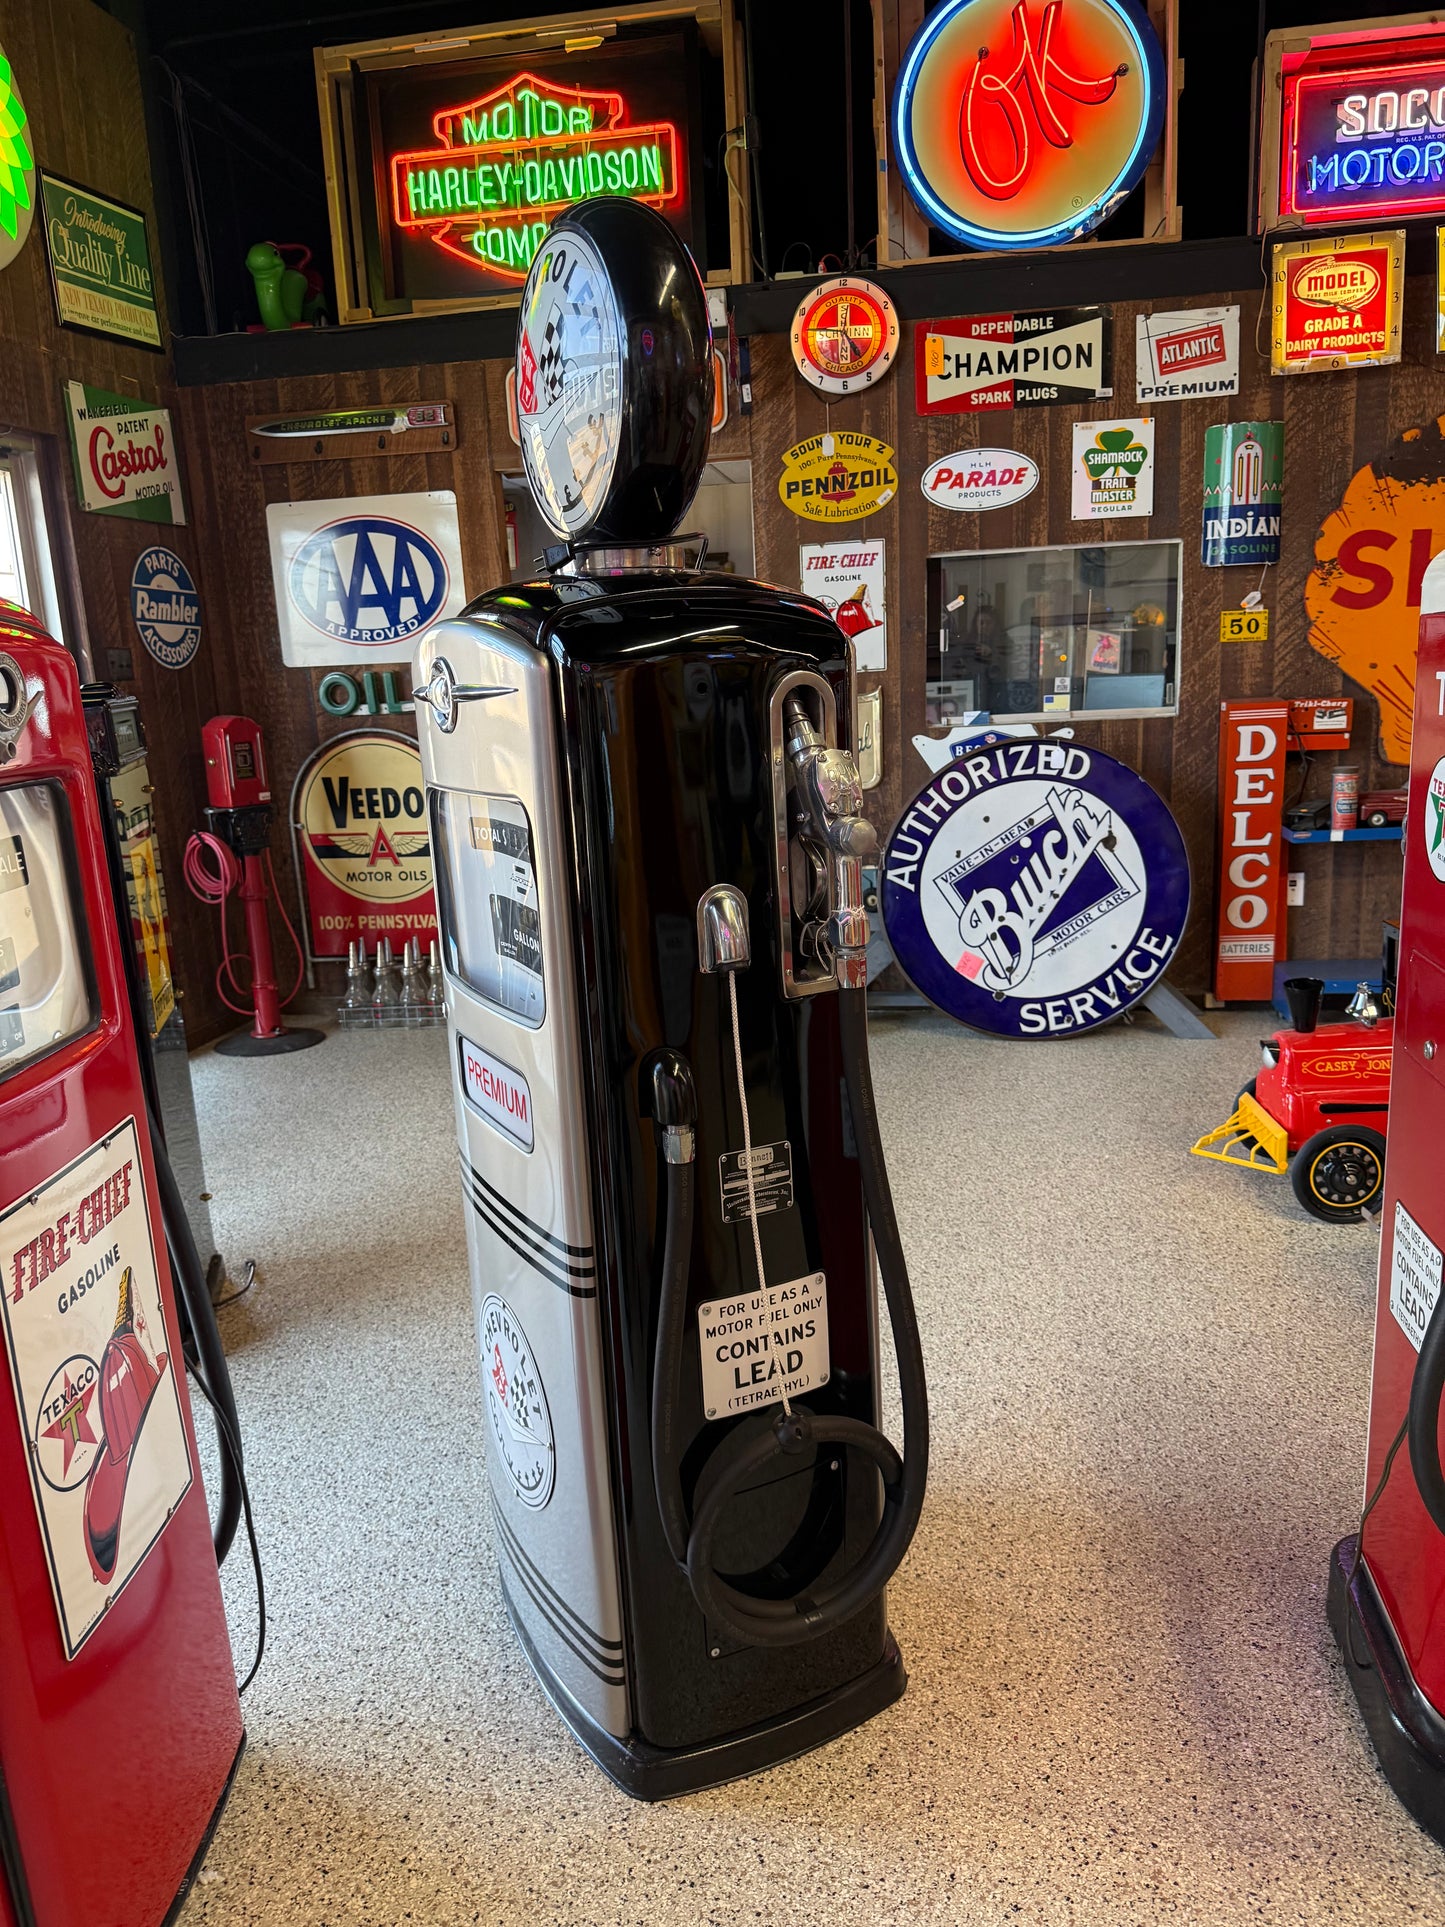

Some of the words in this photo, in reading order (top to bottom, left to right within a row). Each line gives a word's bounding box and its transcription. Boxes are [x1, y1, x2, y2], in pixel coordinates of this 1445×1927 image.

[462, 89, 593, 144] MOTOR
[408, 145, 661, 211] HARLEY-DAVIDSON
[64, 196, 126, 244] Introducing
[1301, 242, 1310, 253] 11
[1333, 237, 1345, 250] 12
[1370, 234, 1374, 245] 1
[50, 217, 114, 287] Quality
[115, 243, 151, 293] Line
[1393, 257, 1400, 269] 2
[839, 279, 848, 287] 12
[1275, 270, 1286, 282] 10
[1307, 270, 1367, 292] MODEL
[816, 287, 823, 296] 11
[866, 283, 870, 291] 1
[825, 296, 865, 307] QUALITY
[883, 300, 889, 310] 2
[1393, 291, 1399, 303] 3
[114, 304, 153, 329] PRODUCTS
[799, 307, 806, 317] 10
[1275, 304, 1283, 317] 9
[890, 326, 896, 336] 3
[971, 316, 1054, 336] DEPENDABLE
[1304, 315, 1350, 334] GRADE
[1353, 314, 1363, 329] A
[1390, 324, 1399, 337] 4
[794, 333, 799, 343] 9
[1274, 337, 1282, 350] 8
[1286, 338, 1320, 353] DAIRY
[1322, 331, 1385, 349] PRODUCTS
[883, 352, 890, 362] 4
[1161, 334, 1221, 366] ATLANTIC
[825, 360, 864, 373] CHICAGO
[936, 342, 1093, 381] CHAMPION
[1331, 356, 1340, 368] 6
[818, 375, 824, 386] 7
[842, 381, 849, 391] 6
[866, 372, 872, 382] 5
[970, 390, 1011, 405] SPARK
[1016, 386, 1059, 402] PLUGS
[1141, 379, 1235, 399] PREMIUM
[77, 403, 130, 421] WAKEFIELD
[117, 418, 150, 435] PATENT
[790, 437, 823, 460] SOUN
[838, 433, 872, 449] YOUR
[875, 443, 887, 454] Z
[89, 424, 168, 499] Castrol
[798, 458, 816, 471] 100%
[817, 454, 834, 463] Pure
[835, 452, 878, 467] Pennsylvania
[1087, 450, 1144, 465] SHAMROCK
[786, 467, 896, 500] PENNZOIL
[929, 466, 1030, 491] PARADE
[1098, 477, 1129, 490] TRAIL
[135, 483, 161, 500] MOTOR
[162, 480, 174, 493] OIL
[958, 489, 1002, 499] PRODUCTS
[1091, 490, 1134, 503] MASTER
[803, 501, 823, 516] Safe
[824, 499, 878, 518] Lubrication
[1091, 504, 1133, 513] REGULAR
[1210, 543, 1277, 556] GASOLINE
[144, 552, 181, 578] PARTS
[806, 552, 879, 571] FIRE-CHIEF
[305, 531, 430, 629] AAA
[824, 574, 862, 582] GASOLINE
[136, 590, 199, 624] Rambler
[326, 619, 419, 642] APPROVED
[1229, 617, 1260, 635] 50
[143, 628, 198, 664] ACCESSORIES
[318, 671, 402, 718] OIL
[886, 744, 1092, 892] AUTHORIZED
[1226, 724, 1277, 930] DELCO
[474, 825, 502, 844] TOTAL
[345, 869, 393, 883] MOTOR
[398, 868, 428, 882] OILS
[958, 786, 1112, 992] Buick
[319, 914, 355, 931] 100%
[1051, 912, 1095, 943] MOTOR
[1097, 887, 1132, 913] CARS
[1220, 943, 1271, 954] BATTERIES
[1019, 927, 1173, 1033] SERVICE
[1315, 1060, 1357, 1073] CASEY
[467, 1055, 528, 1124] PREMIUM
[739, 1152, 773, 1167] Bnnett
[8, 1159, 133, 1305] FIRE-CHIEF
[1401, 1214, 1411, 1236] FOR
[1410, 1227, 1421, 1250] USE
[1421, 1242, 1430, 1259] AS
[1430, 1251, 1435, 1266] A
[1395, 1225, 1411, 1255] MOTOR
[1411, 1248, 1425, 1273] FUEL
[1425, 1264, 1440, 1289] ONLY
[58, 1242, 121, 1315] GASOLINE
[1396, 1250, 1434, 1312] CONTAINS
[719, 1302, 746, 1319] FOR
[780, 1287, 798, 1303] AS
[801, 1284, 810, 1297] A
[1399, 1280, 1426, 1332] LEAD
[706, 1318, 753, 1340] MOTOR
[793, 1296, 823, 1316] ONLY
[716, 1320, 816, 1364] CONTAINS
[484, 1311, 543, 1421] CHEVROLET
[734, 1350, 804, 1390] LEAD
[42, 1365, 95, 1426] TEXACO
[60, 1400, 85, 1445] T
